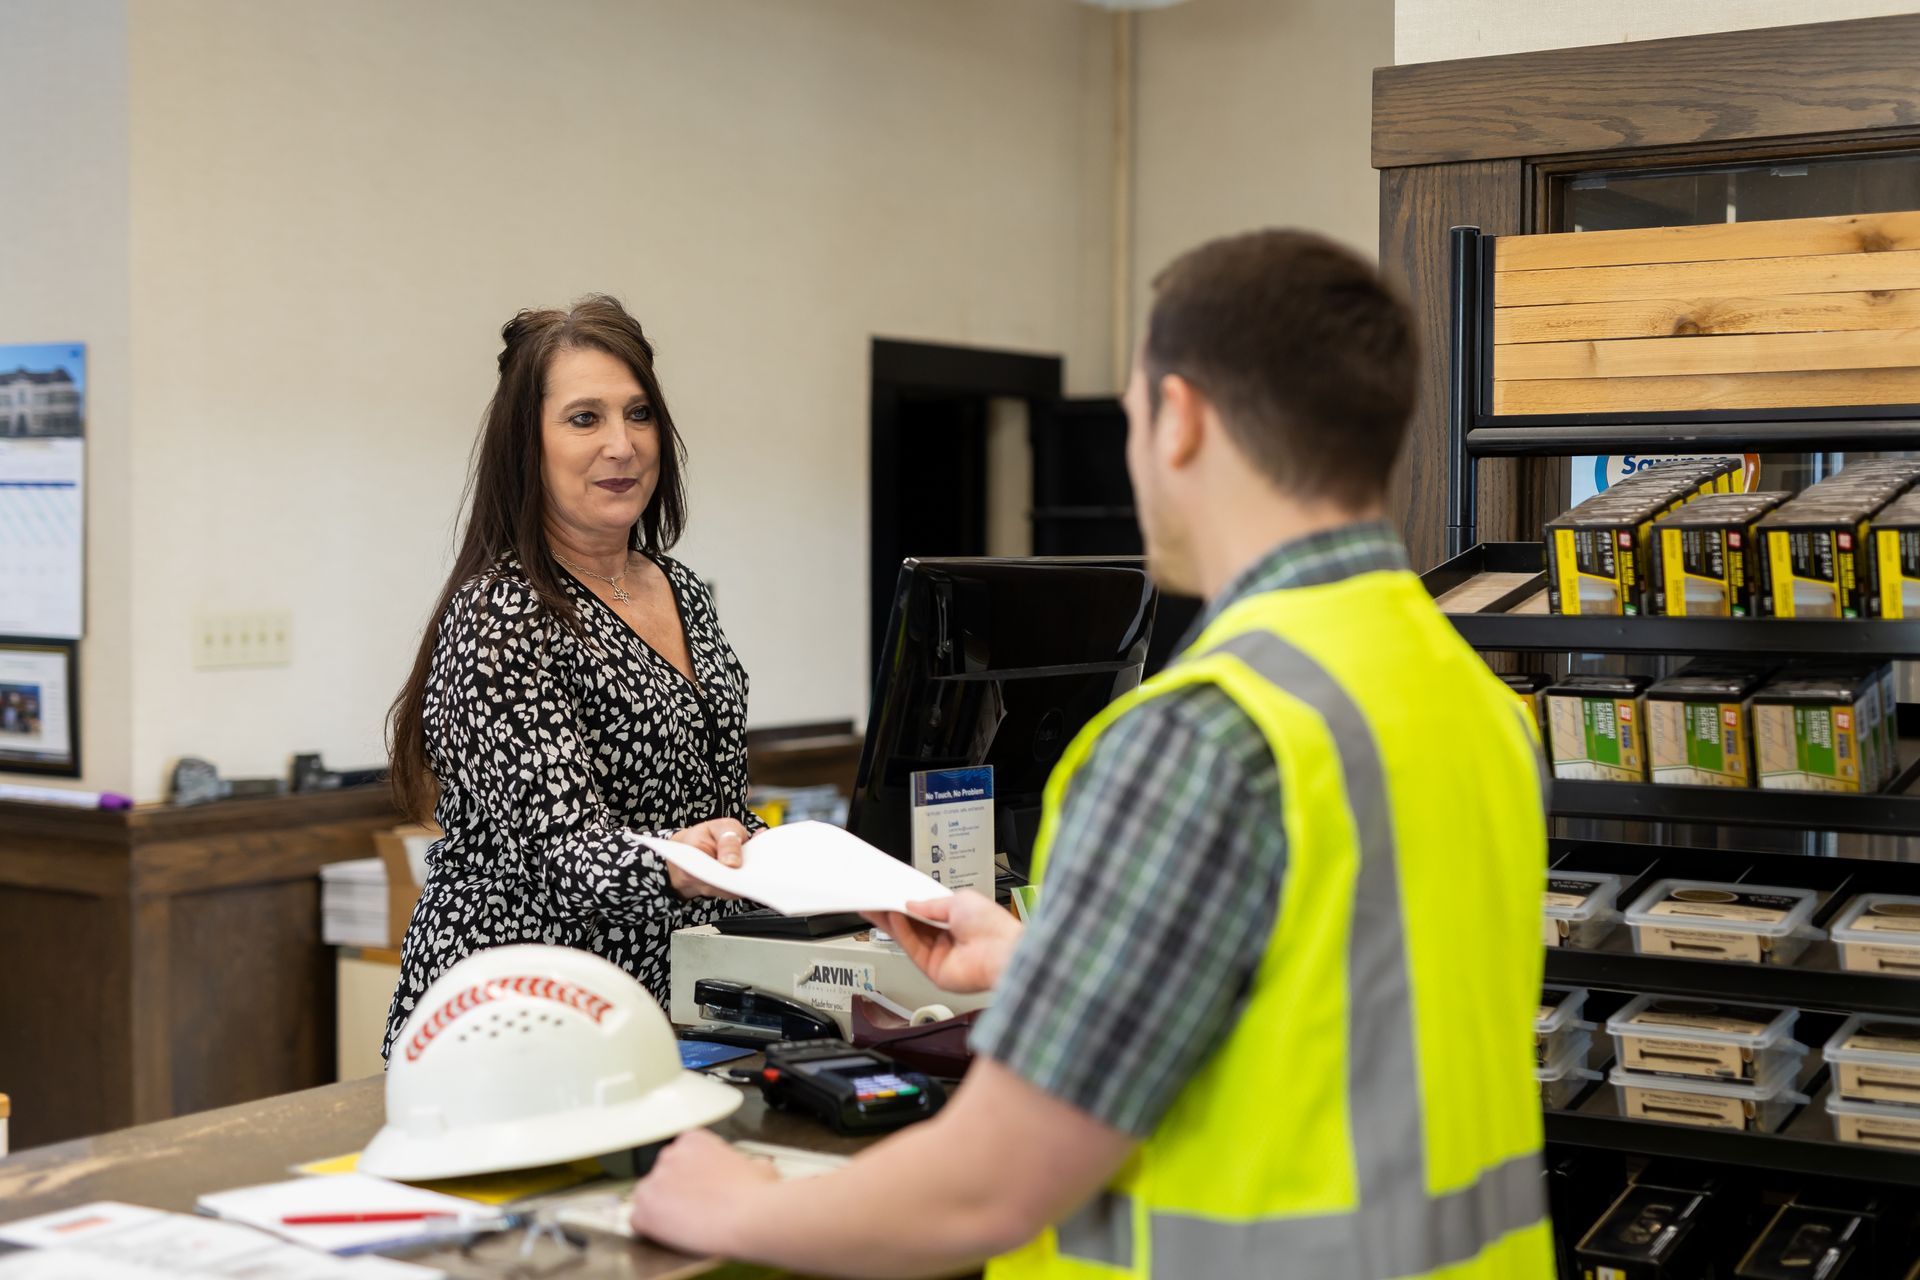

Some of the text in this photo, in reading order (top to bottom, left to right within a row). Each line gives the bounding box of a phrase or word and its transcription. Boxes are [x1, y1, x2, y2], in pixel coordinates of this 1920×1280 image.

[1606, 703, 1616, 739] EXTERIOR
[1709, 707, 1719, 744] EXTERIOR
[934, 791, 952, 799] Touch,
[962, 788, 984, 796] Problem
[811, 998, 826, 1008] Made
